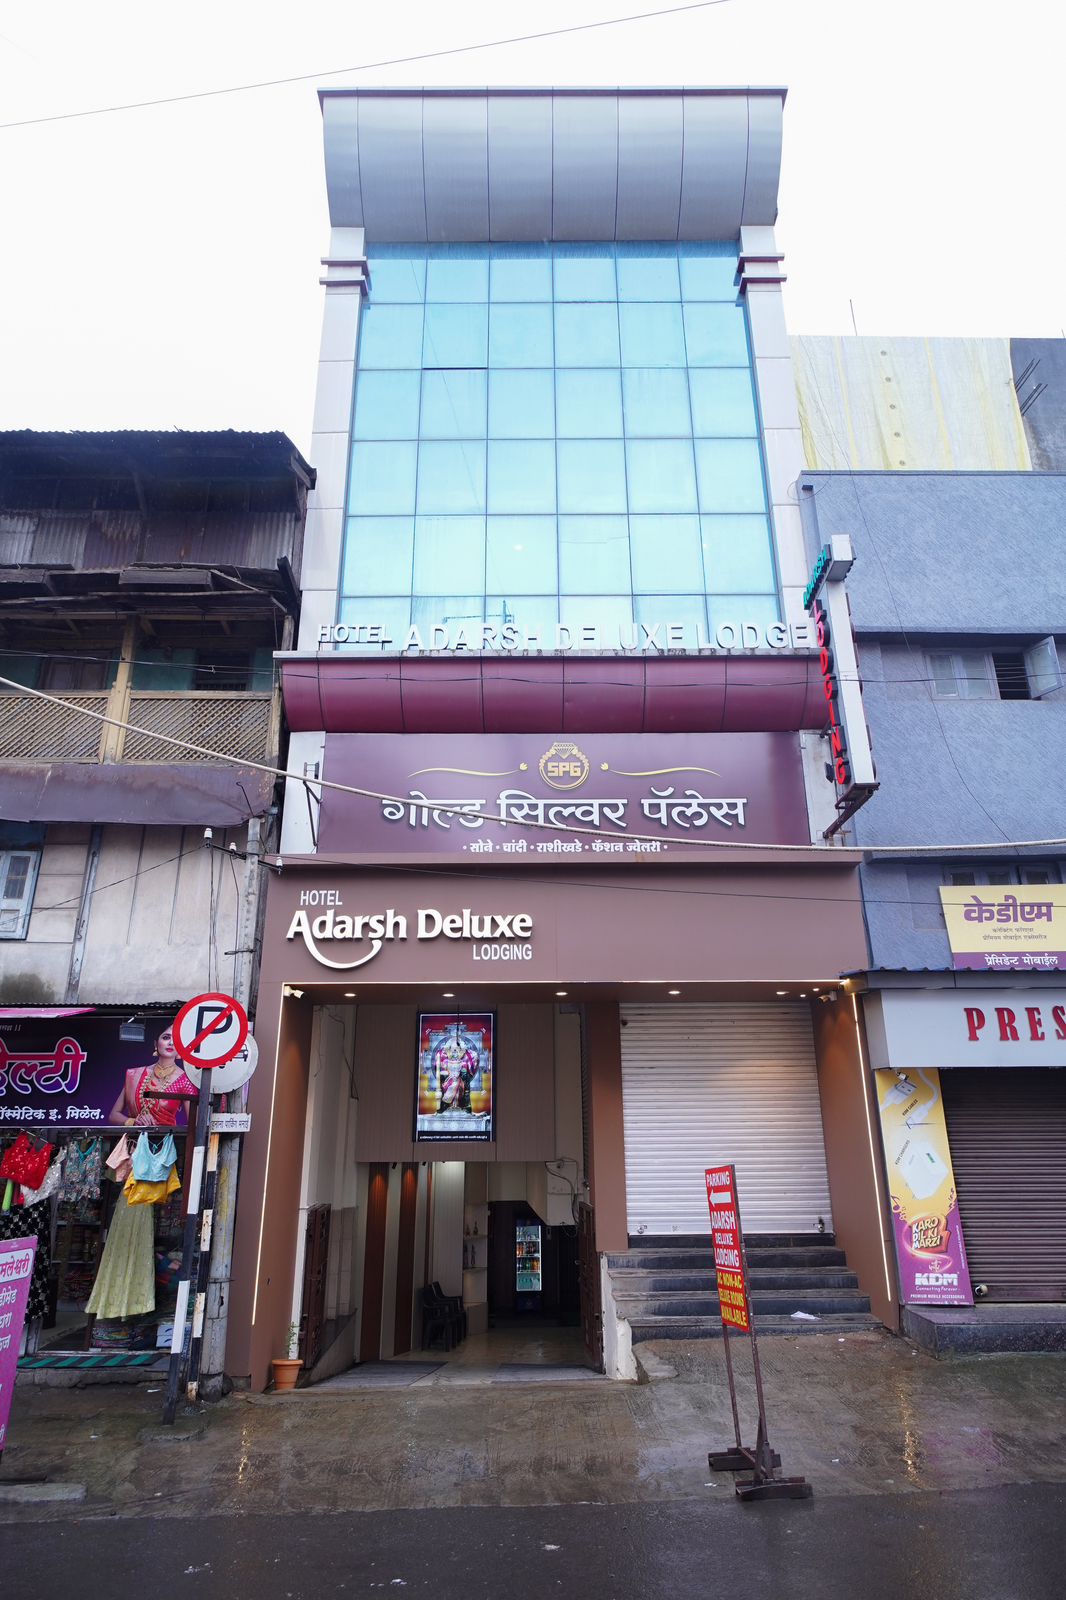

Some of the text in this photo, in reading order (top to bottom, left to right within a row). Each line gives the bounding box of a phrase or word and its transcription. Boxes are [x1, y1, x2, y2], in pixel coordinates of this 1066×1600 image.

[318, 625, 392, 643] HOTEL
[403, 624, 541, 650] ADARSH
[697, 622, 812, 649] LODGE
[547, 761, 581, 778] SPG
[382, 787, 748, 828] गोल्ड सिल्वर पॅलेस
[470, 839, 493, 853] सोने
[300, 890, 342, 906] HOTEL
[963, 894, 1054, 923] केडीएम
[286, 908, 533, 969] Adarsh Deluxe
[473, 944, 533, 961] LODGING
[1022, 952, 1058, 968] मोबाईल
[706, 1172, 730, 1186] PARKING
[711, 1211, 736, 1229] ADARSH
[912, 1217, 939, 1234] KARO
[715, 1233, 734, 1246] DELUXE
[912, 1228, 939, 1243] DIL KI
[912, 1236, 940, 1249] MARZI
[714, 1247, 740, 1267] LODGING
[914, 1272, 959, 1286] KDM
